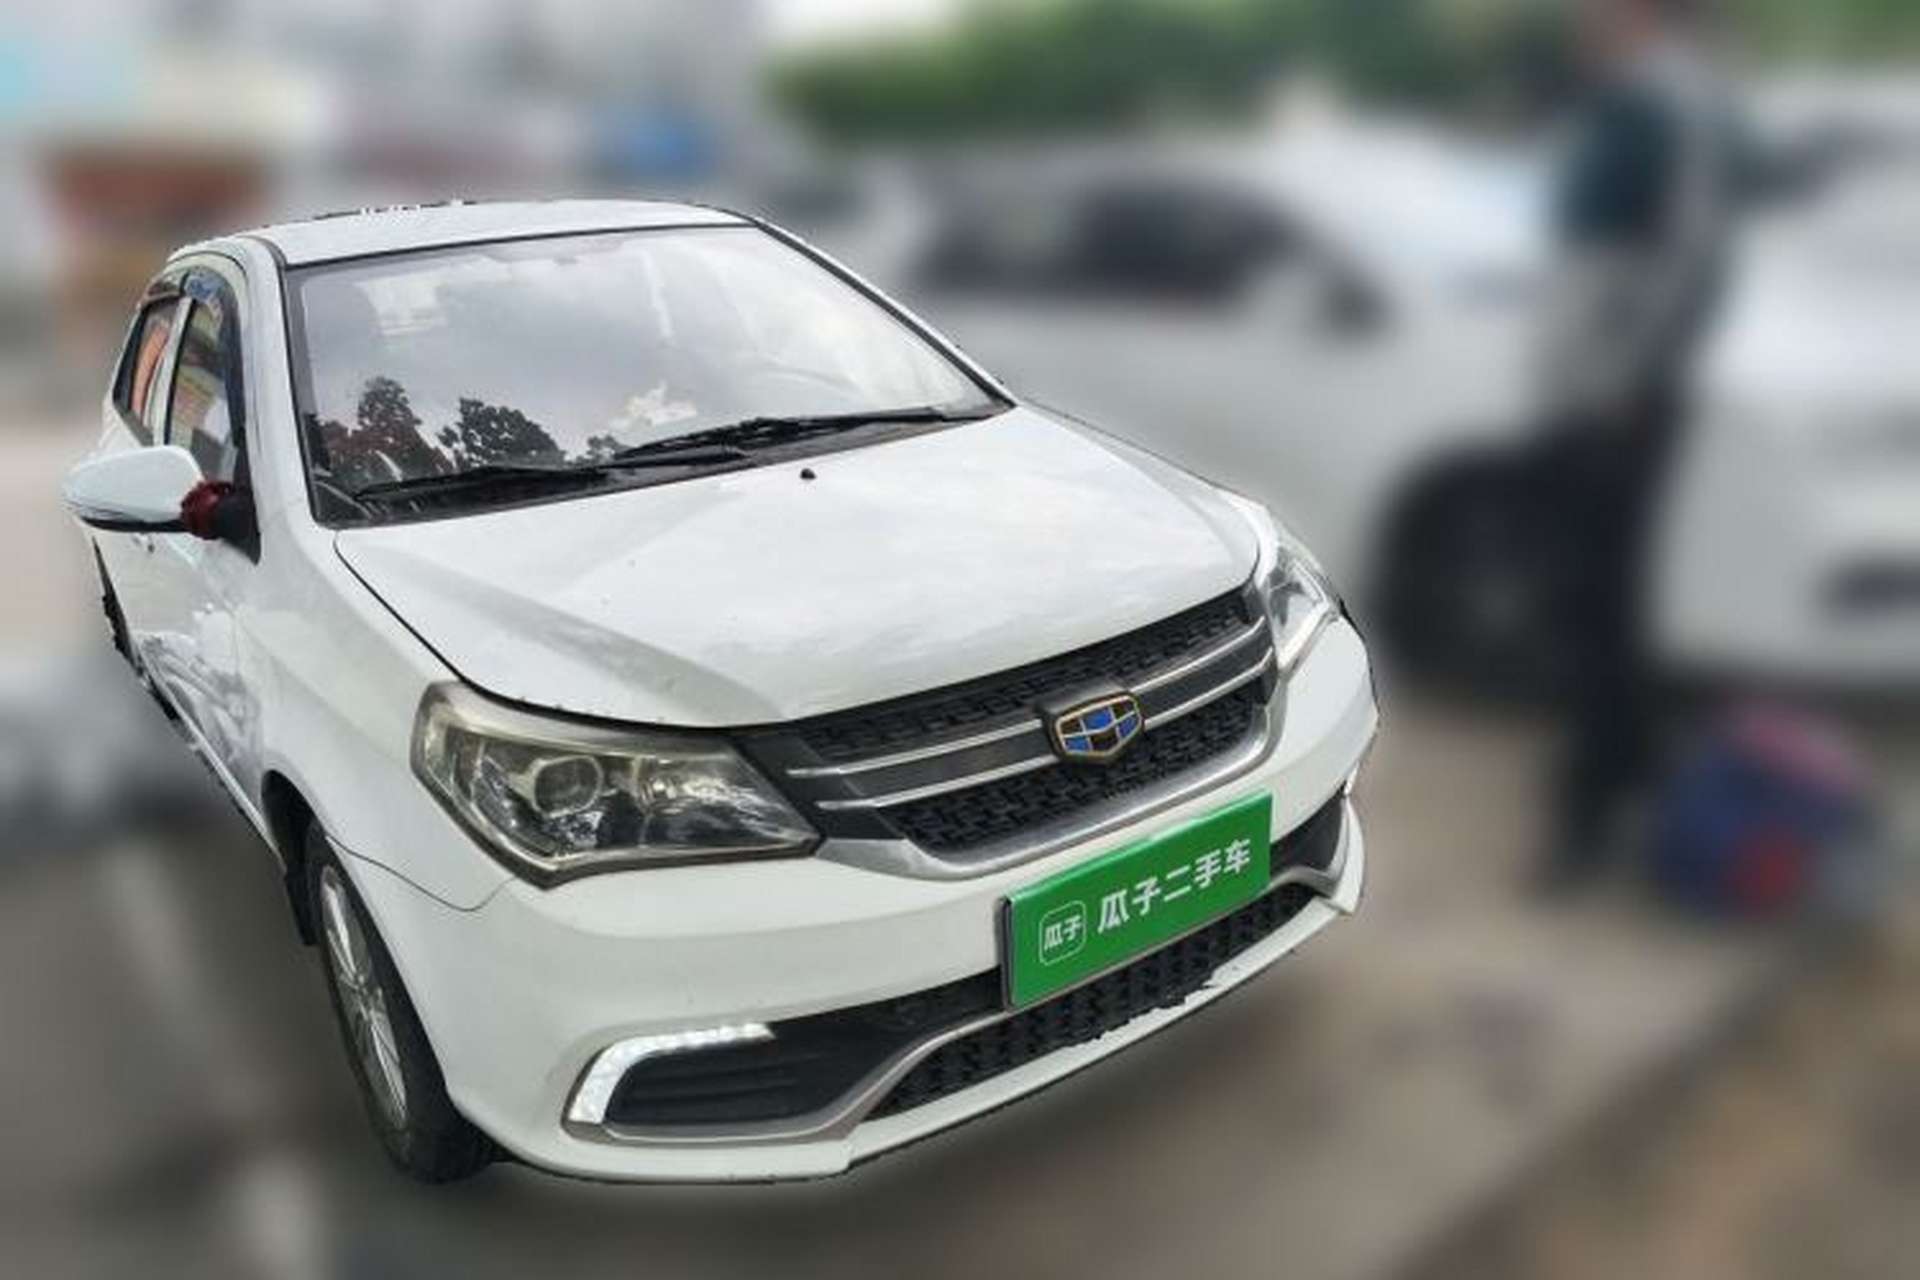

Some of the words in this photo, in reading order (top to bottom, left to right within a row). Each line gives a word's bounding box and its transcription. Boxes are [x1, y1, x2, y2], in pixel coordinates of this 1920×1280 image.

[1097, 838, 1251, 934] 瓜子二手车
[1043, 914, 1082, 951] 瓜子
